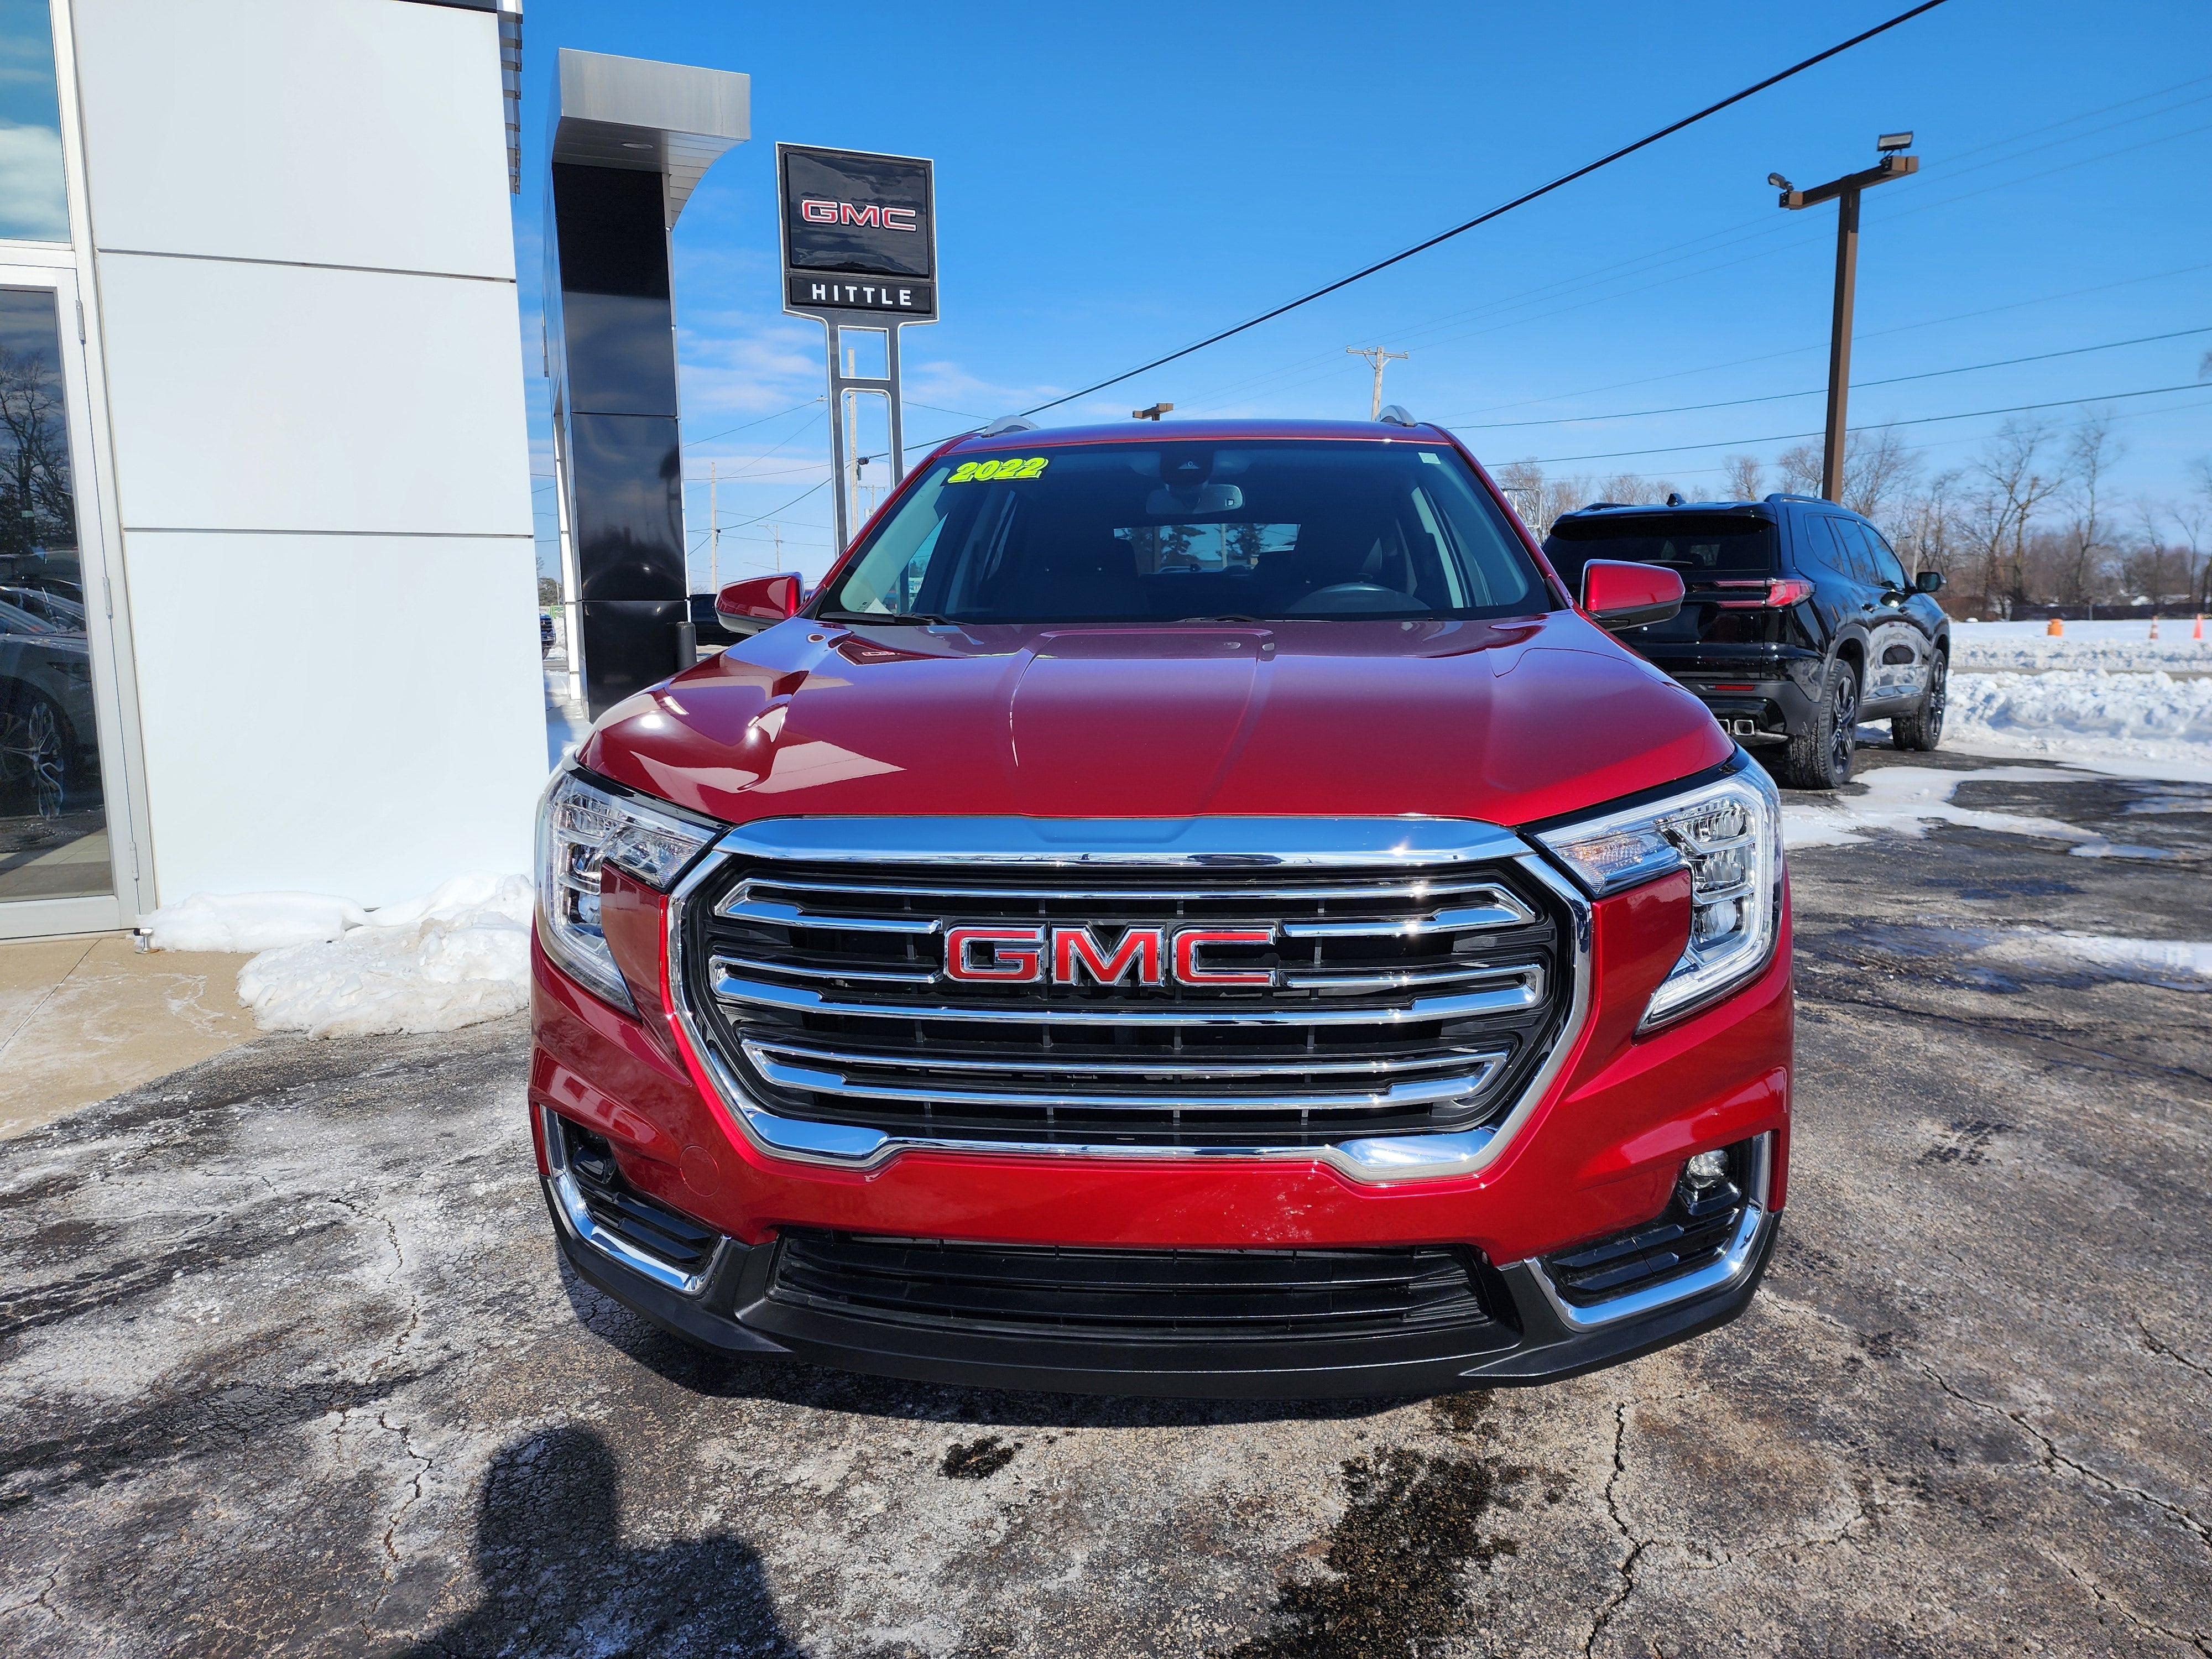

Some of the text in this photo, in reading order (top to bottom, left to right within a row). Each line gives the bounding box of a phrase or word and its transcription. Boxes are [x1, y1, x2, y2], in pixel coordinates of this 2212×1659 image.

[802, 200, 916, 232] GMC
[812, 284, 911, 306] HITTLE
[947, 457, 1049, 483] 2022
[943, 925, 1276, 987] GMC
